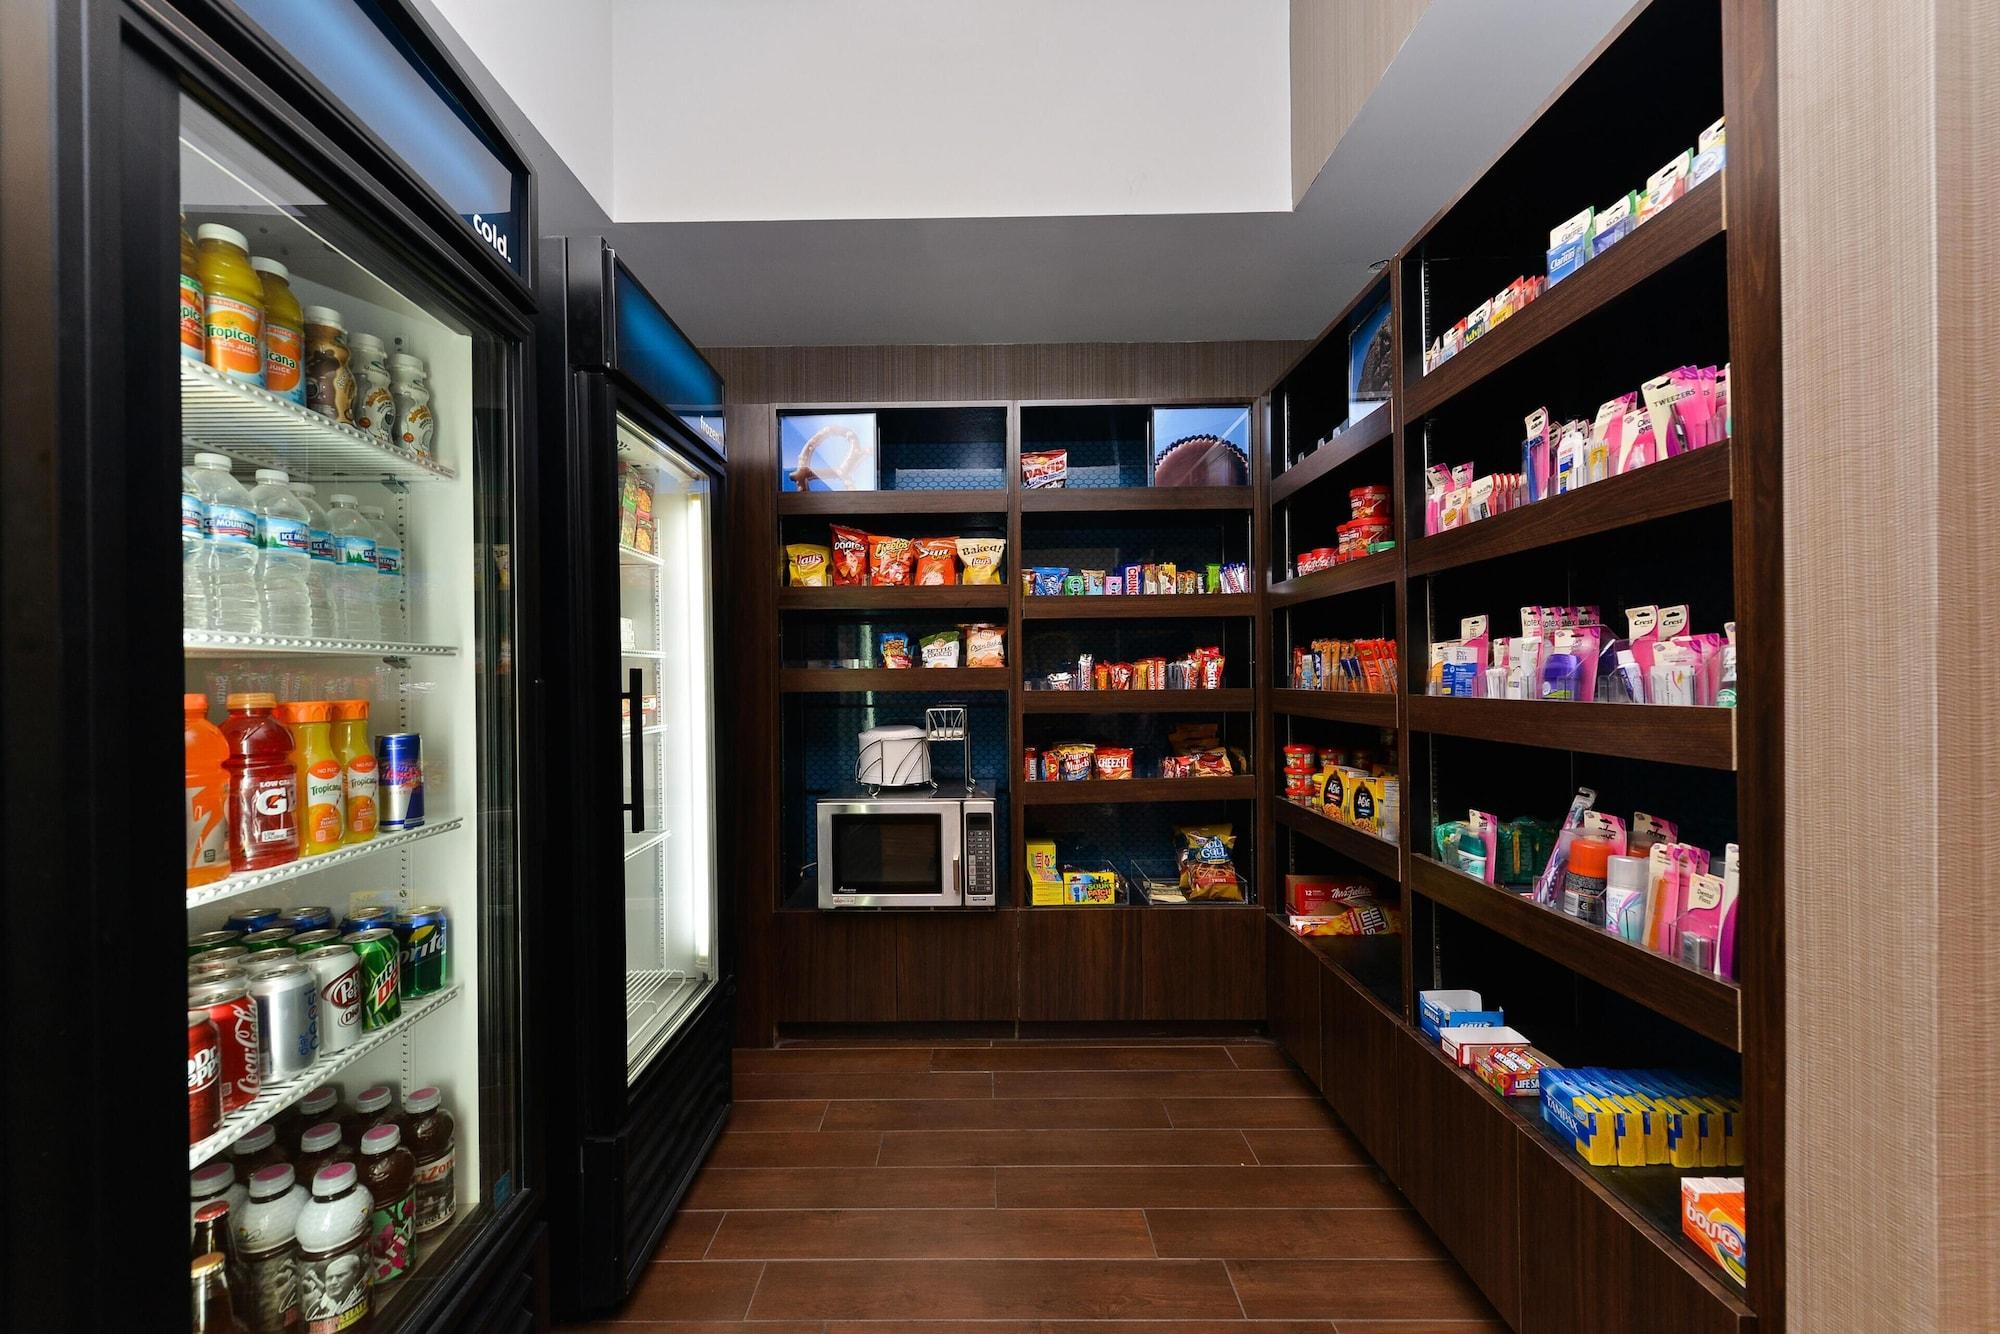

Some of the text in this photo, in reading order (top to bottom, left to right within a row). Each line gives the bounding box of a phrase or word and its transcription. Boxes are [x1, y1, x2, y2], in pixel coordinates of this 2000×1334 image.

[1653, 388, 1697, 408] TWEEZERS
[281, 533, 294, 541] ICE
[961, 541, 1003, 556] Baked!
[1662, 618, 1683, 626] Crest
[1087, 881, 1110, 890] SOUR
[1087, 888, 1112, 897] PATCH
[1545, 1093, 1578, 1134] TAMPAX
[1686, 1199, 1741, 1253] bounce
